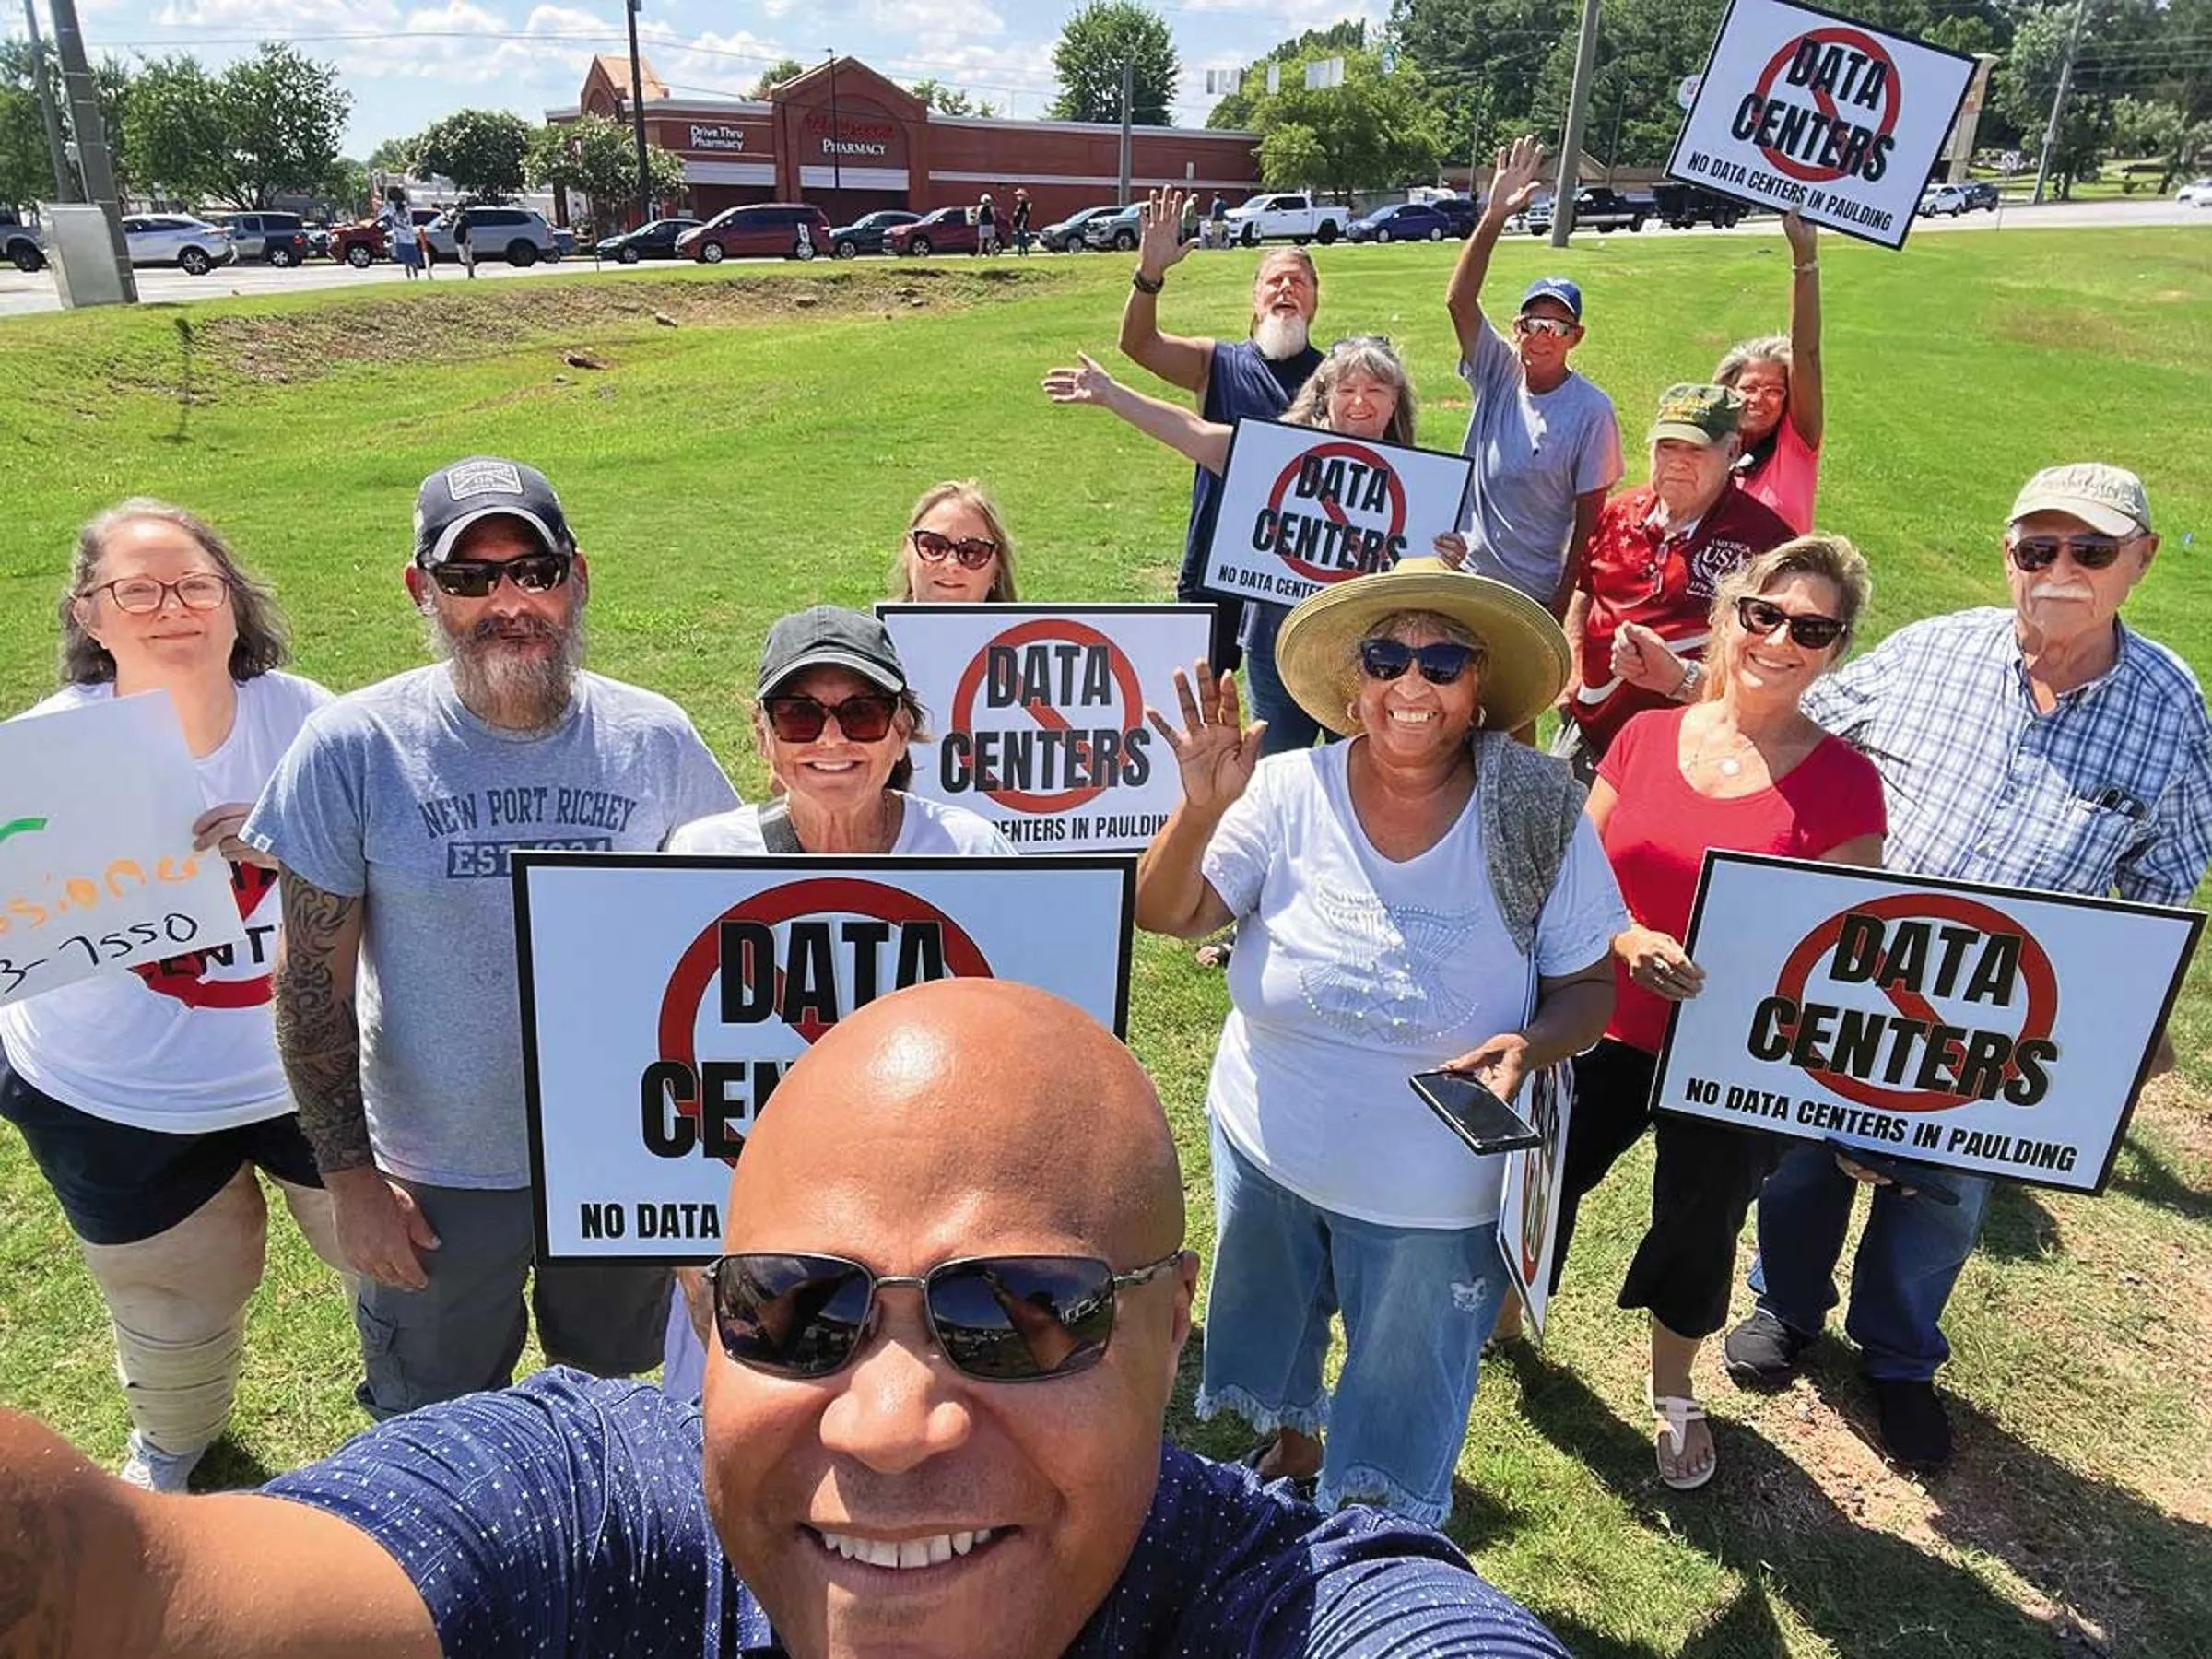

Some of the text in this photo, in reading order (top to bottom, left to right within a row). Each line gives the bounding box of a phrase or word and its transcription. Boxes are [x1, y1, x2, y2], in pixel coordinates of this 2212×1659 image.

[1786, 37, 1888, 111] DATA
[691, 124, 744, 139] Drive Thru
[692, 137, 744, 152] Pharmacy
[1731, 92, 1895, 182] CENTERS
[1688, 151, 1894, 231] NO DATA CENTERS IN PAULDING
[1295, 453, 1389, 514] DATA
[1252, 508, 1407, 573] CENTERS
[1218, 563, 1238, 583] NO
[1240, 569, 1273, 593] DATA
[986, 644, 1112, 709] DATA
[940, 728, 1152, 794] CENTERS
[418, 786, 638, 840] NEW PORT RICHEY
[1072, 817, 1089, 840] IN
[719, 921, 947, 1025] DATA
[1829, 912, 2022, 1007] DATA
[1747, 995, 2059, 1107] CENTERS
[1686, 1077, 2079, 1173] NO DATA CENTERS IN PAULDING
[580, 1202, 722, 1239] NO DATA
